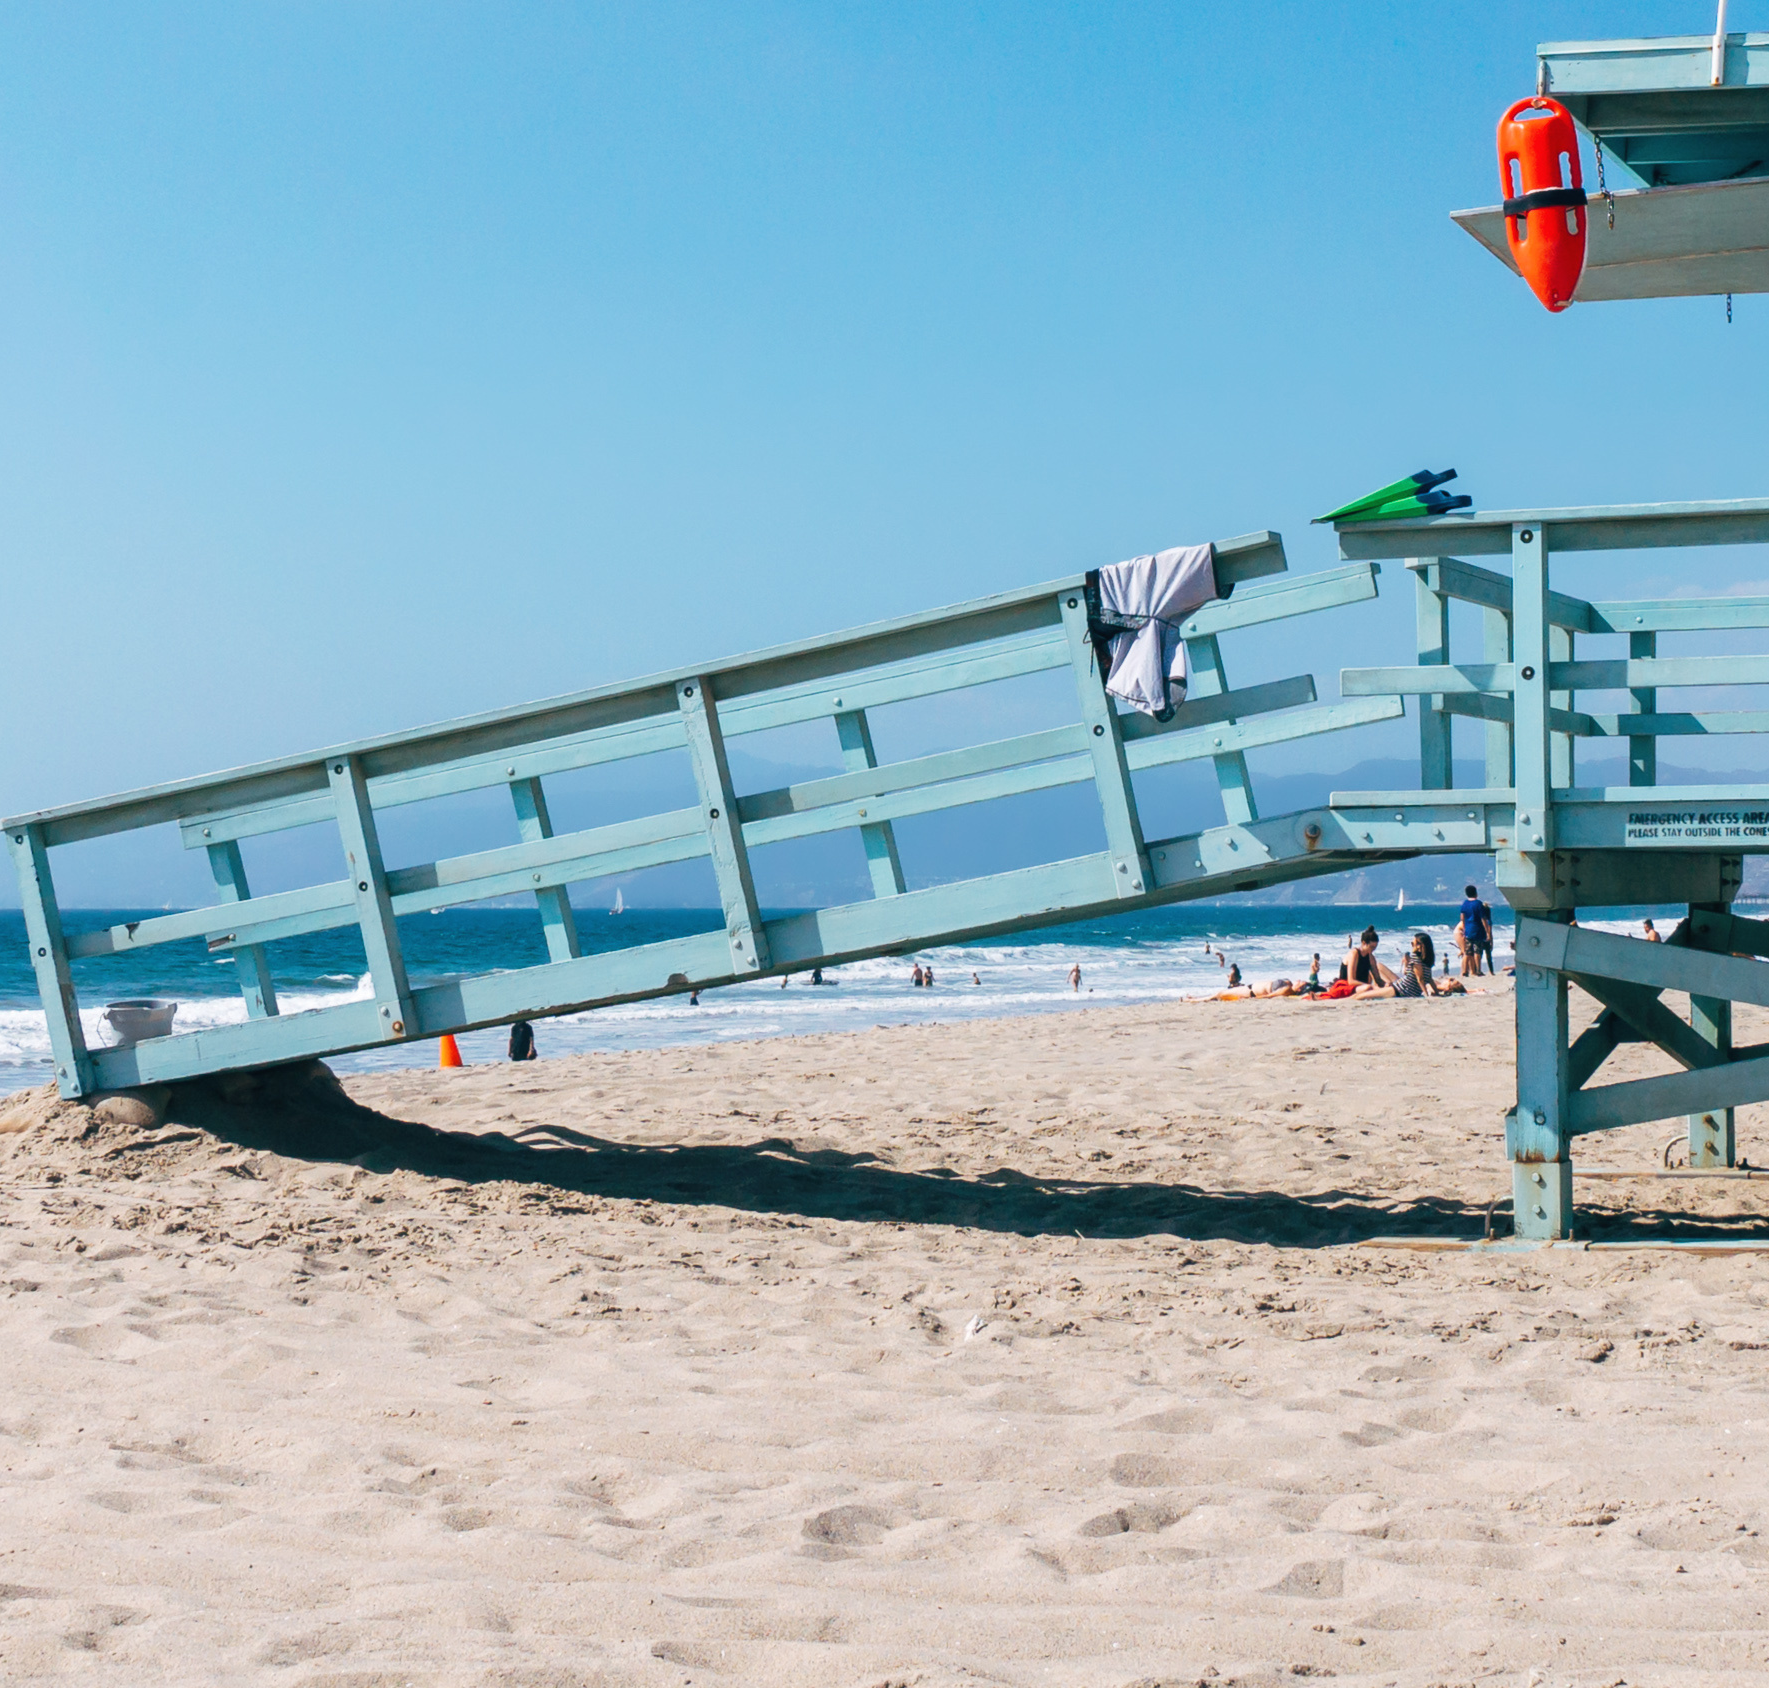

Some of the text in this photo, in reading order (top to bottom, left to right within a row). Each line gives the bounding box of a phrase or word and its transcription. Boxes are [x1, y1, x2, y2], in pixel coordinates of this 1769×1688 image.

[1698, 812, 1739, 825] ACCESS
[1628, 827, 1659, 838] PLEASE
[1661, 827, 1682, 837] STAY
[1685, 827, 1722, 838] OUTSIDE
[1724, 826, 1741, 837] THE
